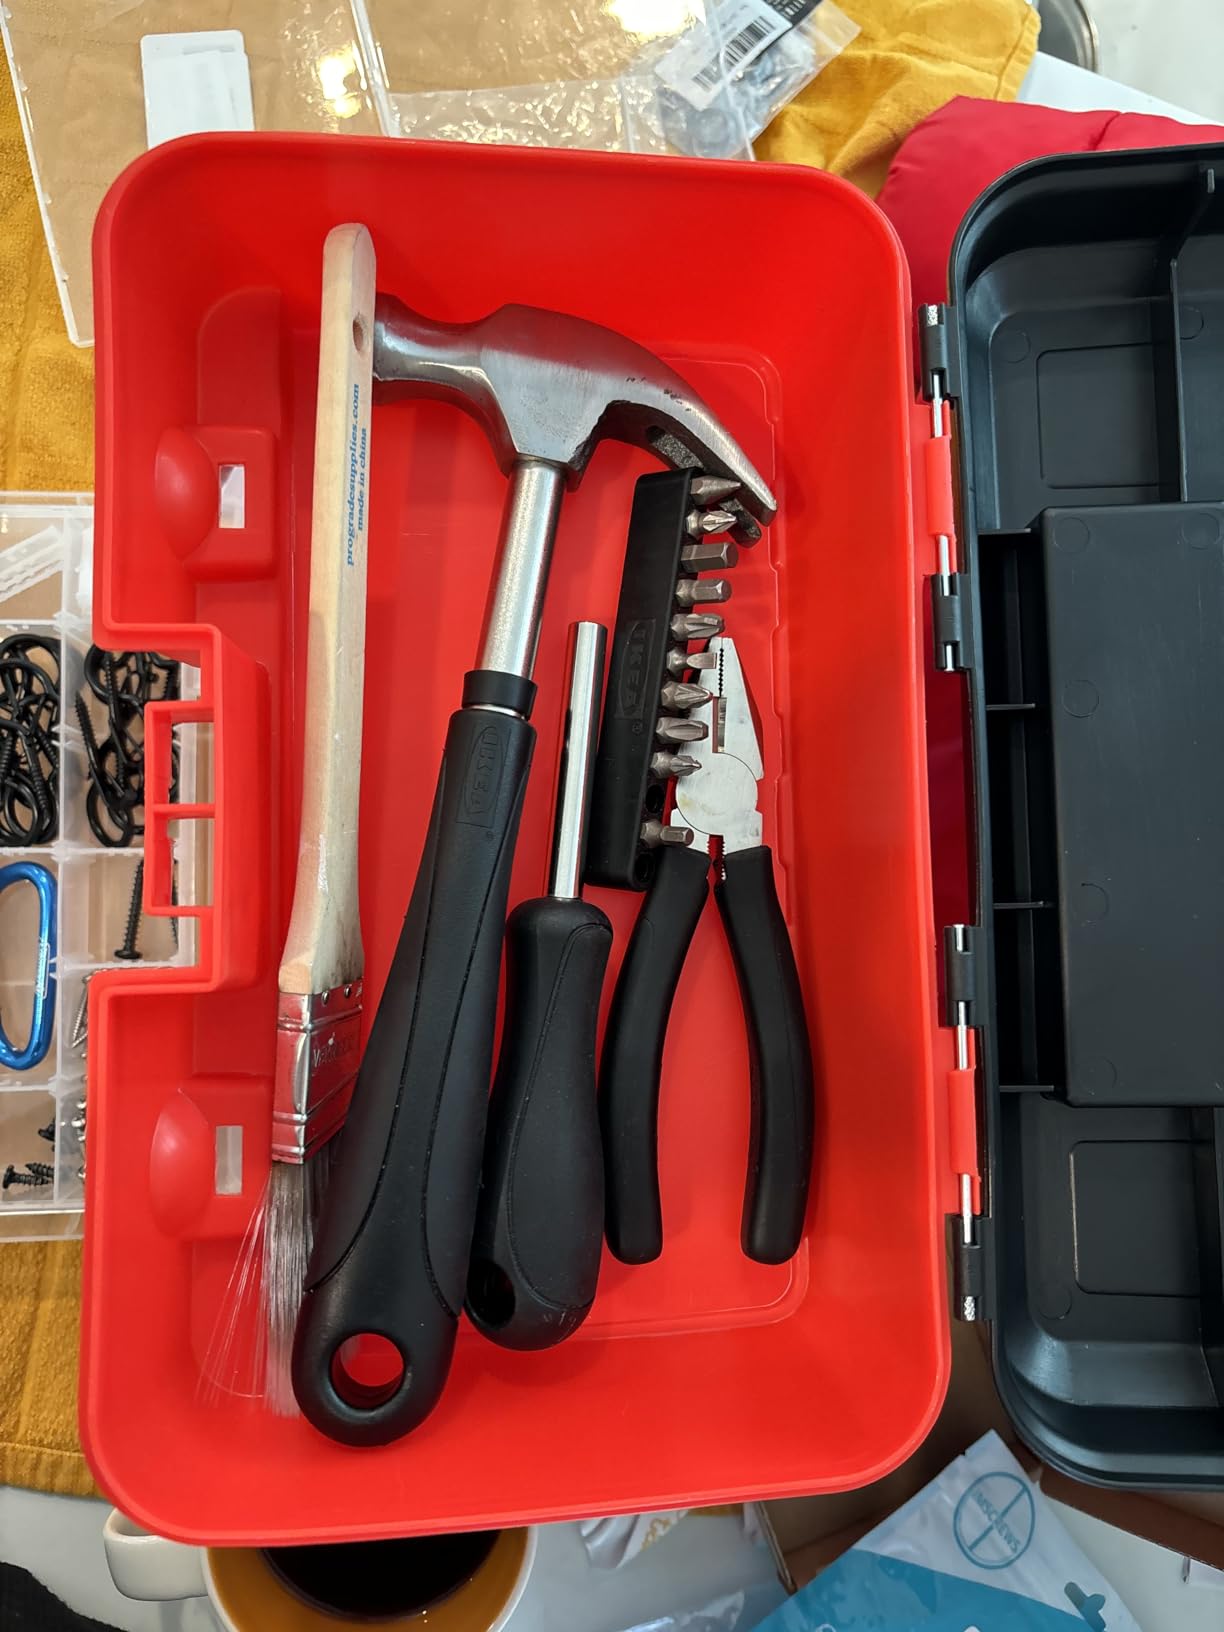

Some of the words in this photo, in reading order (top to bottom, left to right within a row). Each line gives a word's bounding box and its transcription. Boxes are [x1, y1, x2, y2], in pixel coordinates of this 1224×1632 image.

[346, 383, 360, 567] progradesupplies.com
[358, 472, 366, 487] in
[469, 730, 498, 810] IKEA
